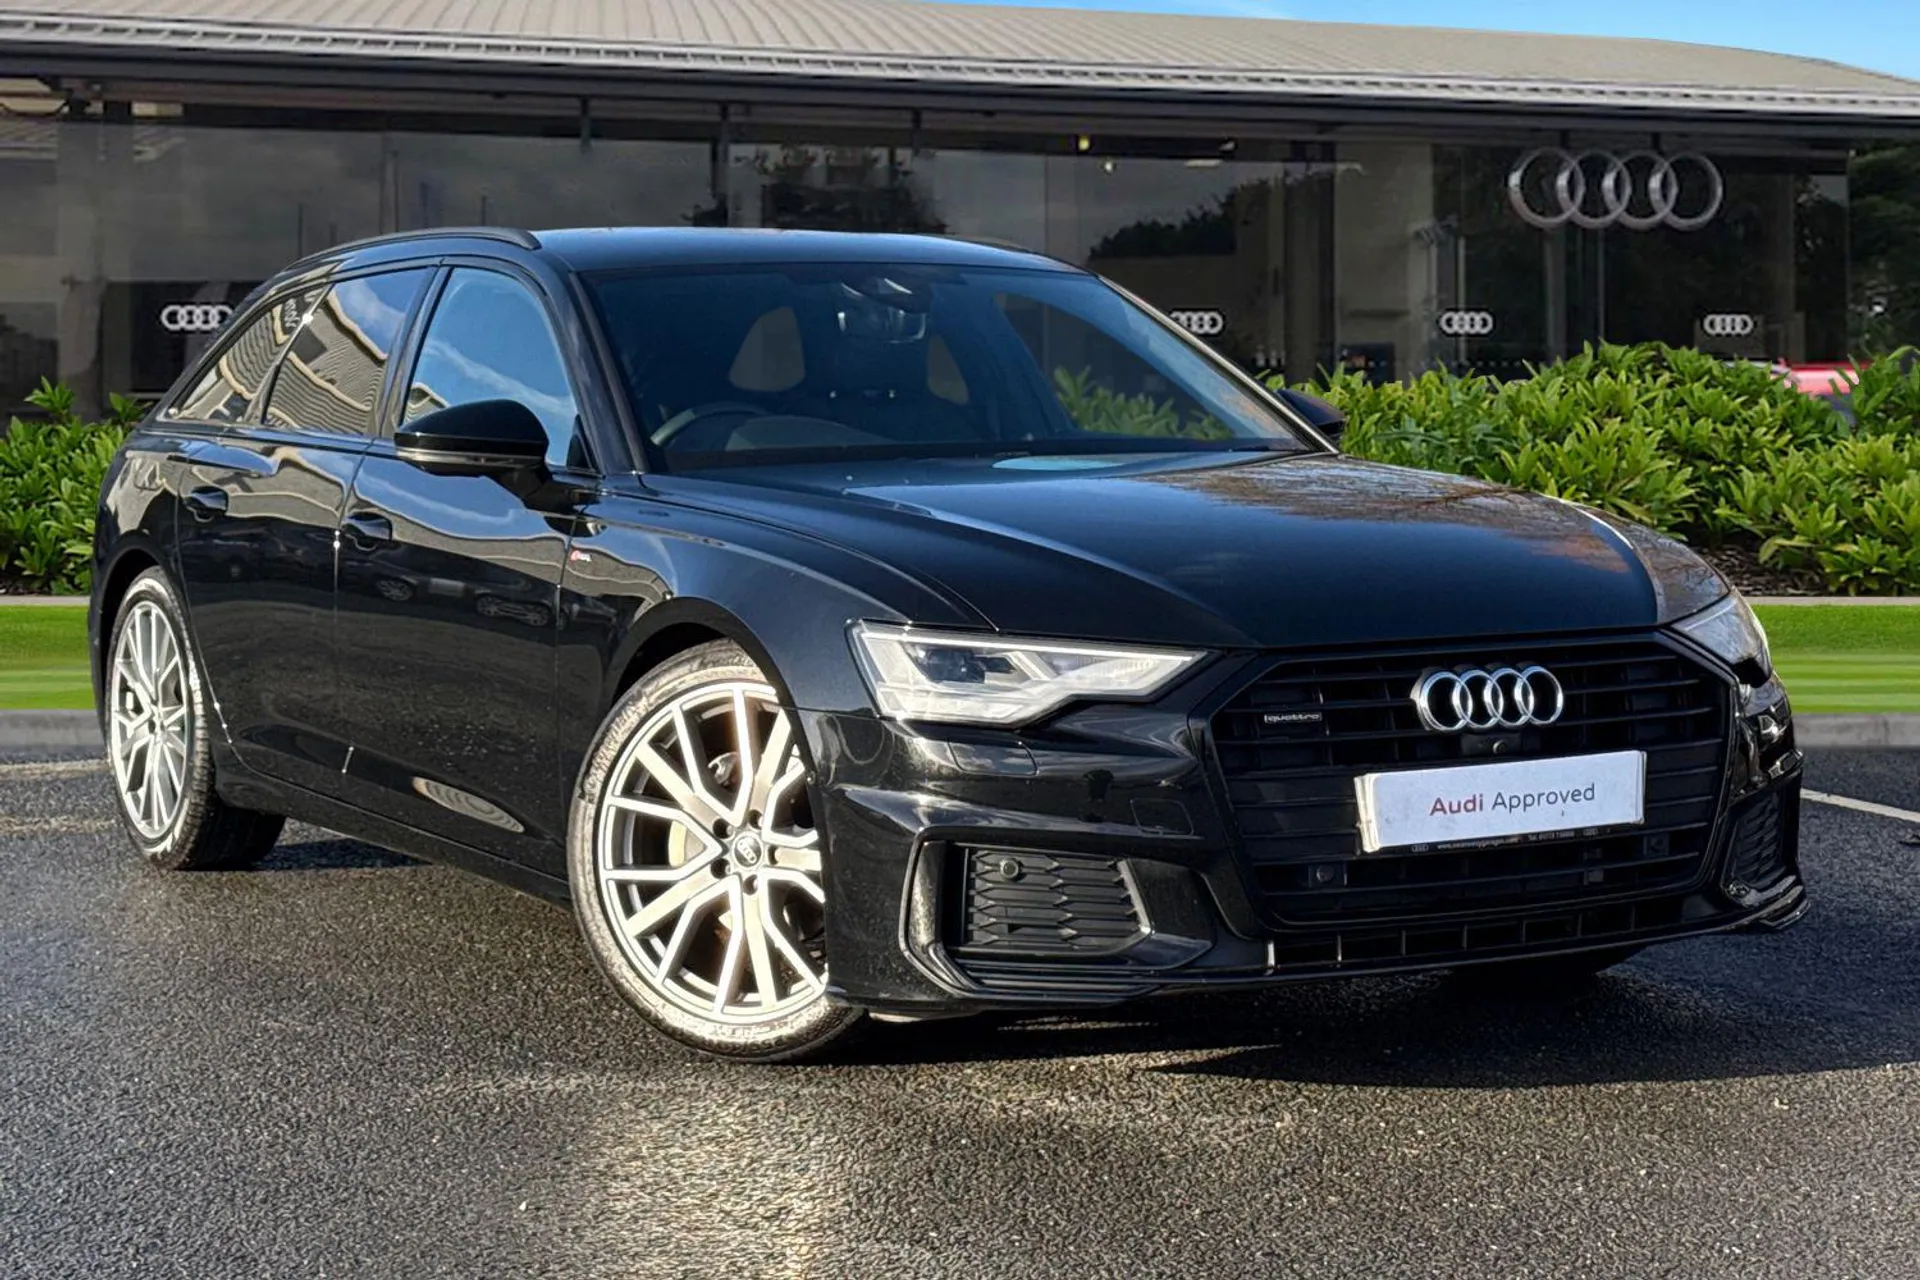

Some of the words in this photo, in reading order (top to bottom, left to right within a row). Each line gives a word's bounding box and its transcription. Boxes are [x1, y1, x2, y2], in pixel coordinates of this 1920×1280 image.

[1267, 711, 1320, 724] quattro
[1429, 794, 1485, 817] Audi
[1491, 783, 1596, 814] Approved
